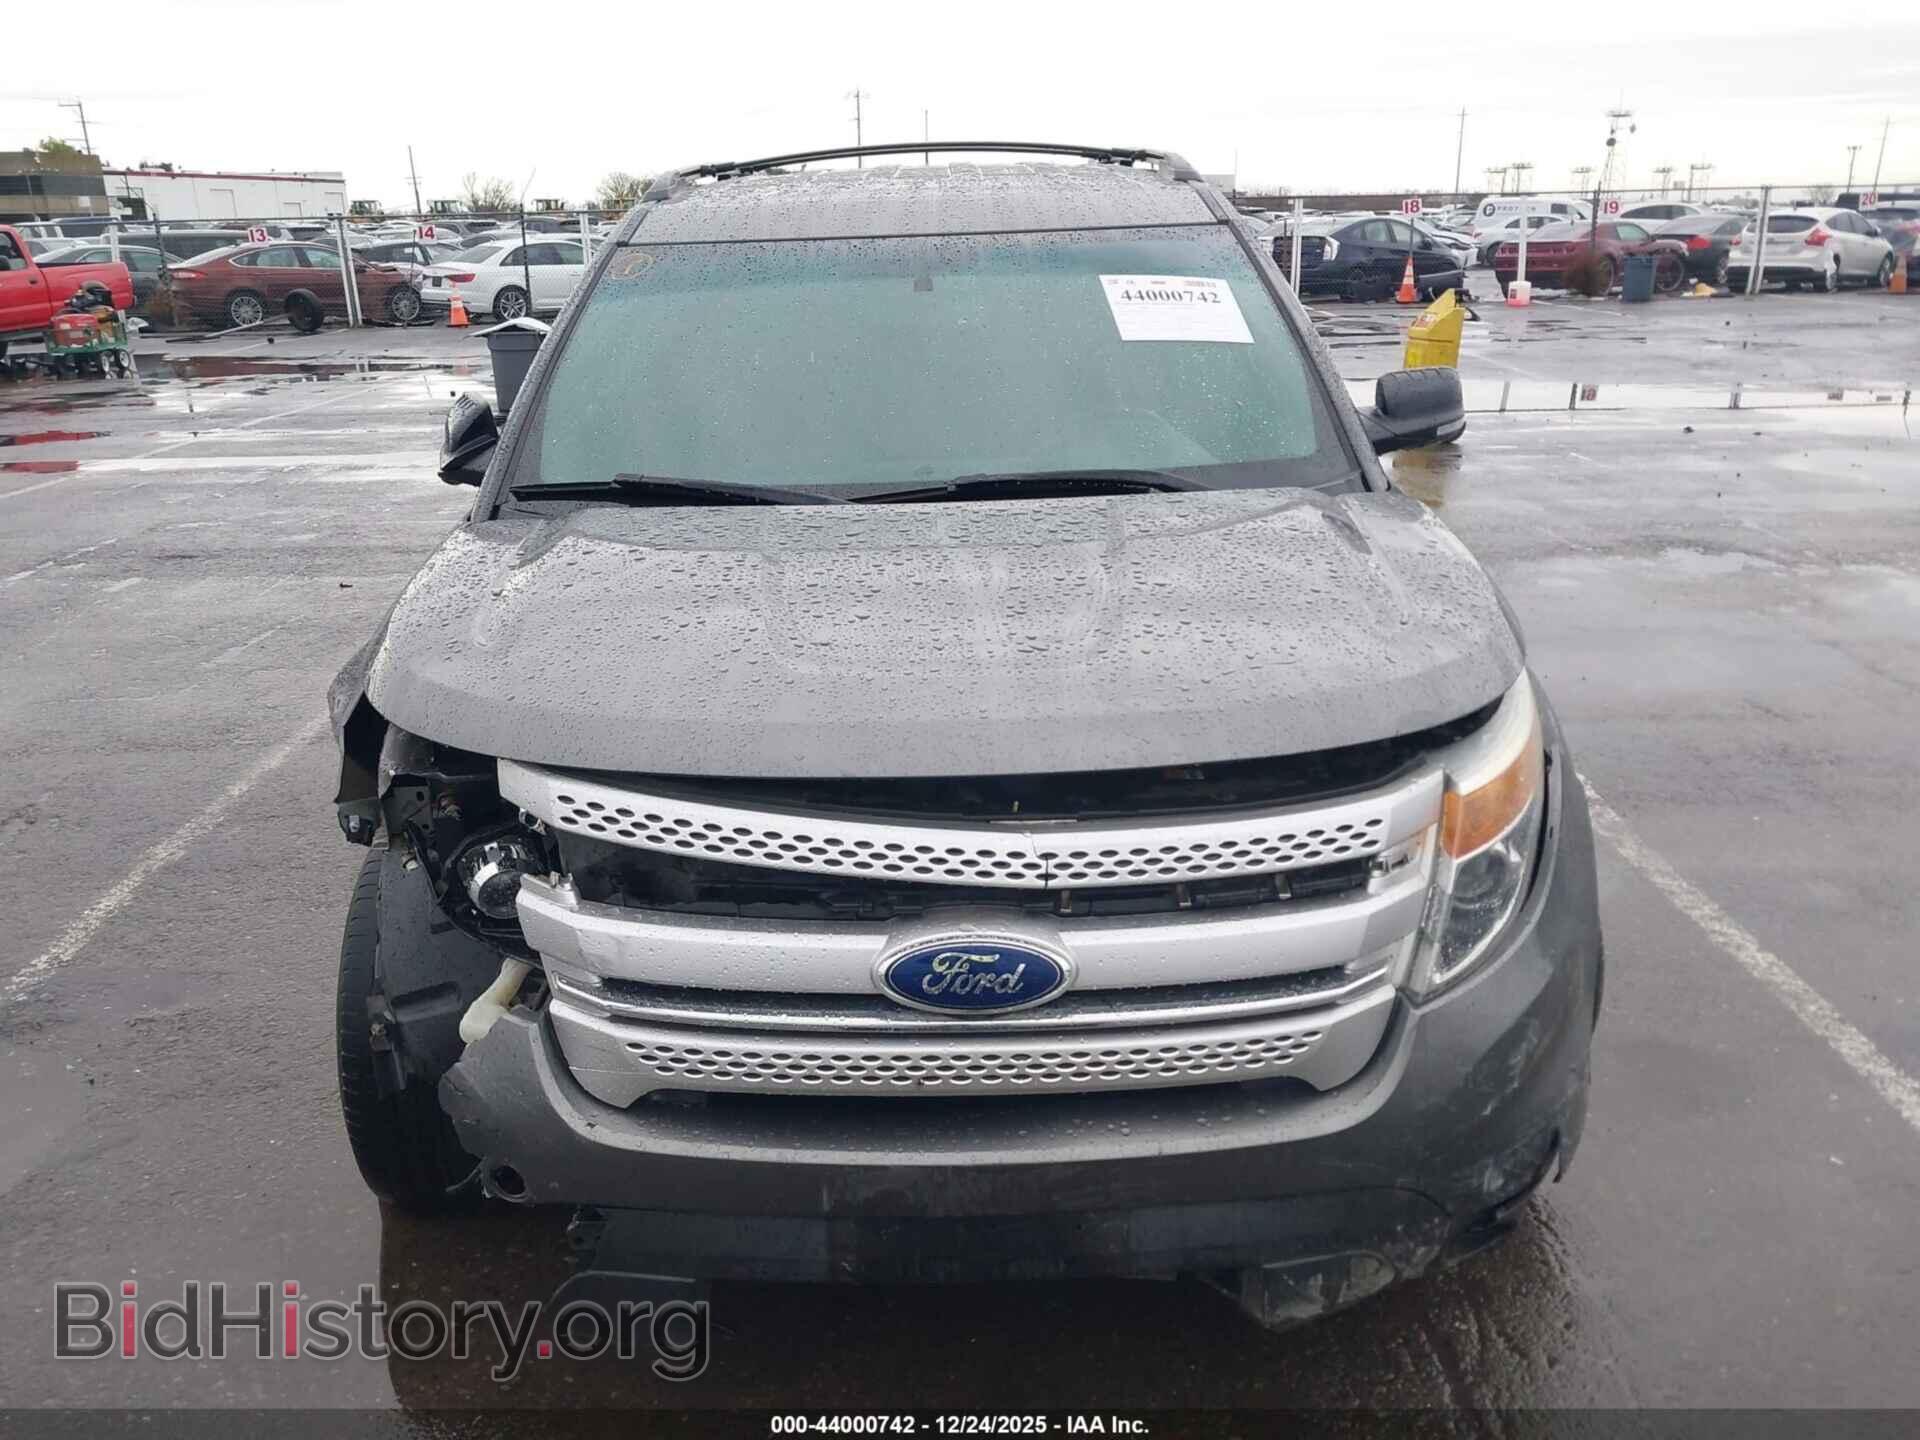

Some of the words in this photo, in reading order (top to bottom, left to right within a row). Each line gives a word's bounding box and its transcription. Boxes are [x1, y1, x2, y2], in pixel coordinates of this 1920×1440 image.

[1404, 199, 1420, 214] 18
[1603, 200, 1619, 215] 19
[250, 228, 267, 242] 13
[418, 225, 435, 240] 14
[1121, 289, 1222, 304] 44000742
[922, 951, 1025, 994] Ford
